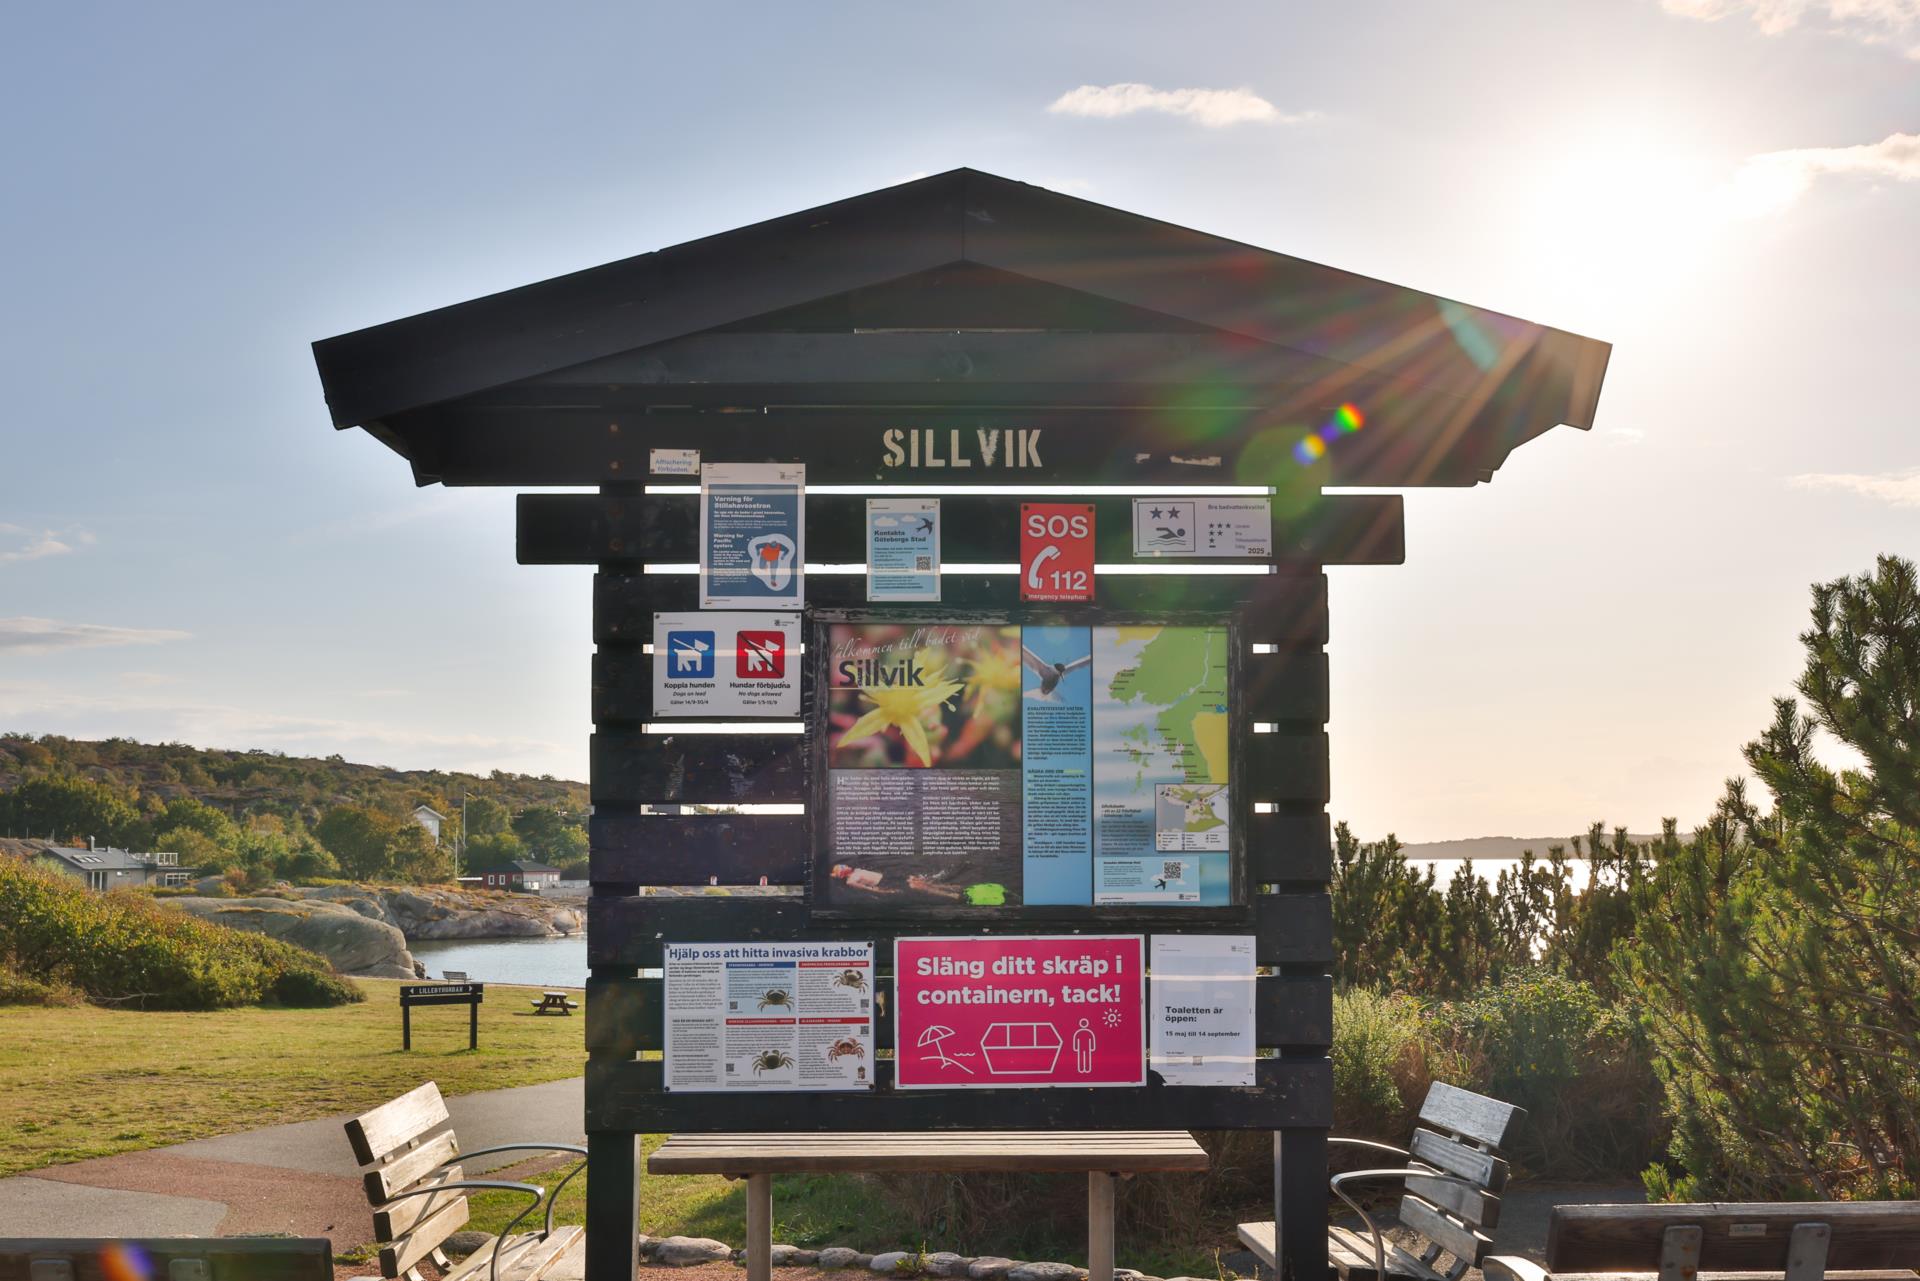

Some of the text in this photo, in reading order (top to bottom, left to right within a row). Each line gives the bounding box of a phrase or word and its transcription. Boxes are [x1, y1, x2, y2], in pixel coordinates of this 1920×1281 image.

[883, 428, 1043, 468] SILLVIK
[1028, 514, 1088, 538] SOS
[1050, 570, 1087, 590] 112
[899, 628, 926, 650] till
[926, 626, 957, 647] badet
[839, 658, 925, 688] Sillvik
[669, 947, 868, 960] Hjälp oss att hitta invasiva krabbor
[917, 955, 1122, 979] Släng ditt skräp i
[917, 984, 1121, 1006] containern, tack!
